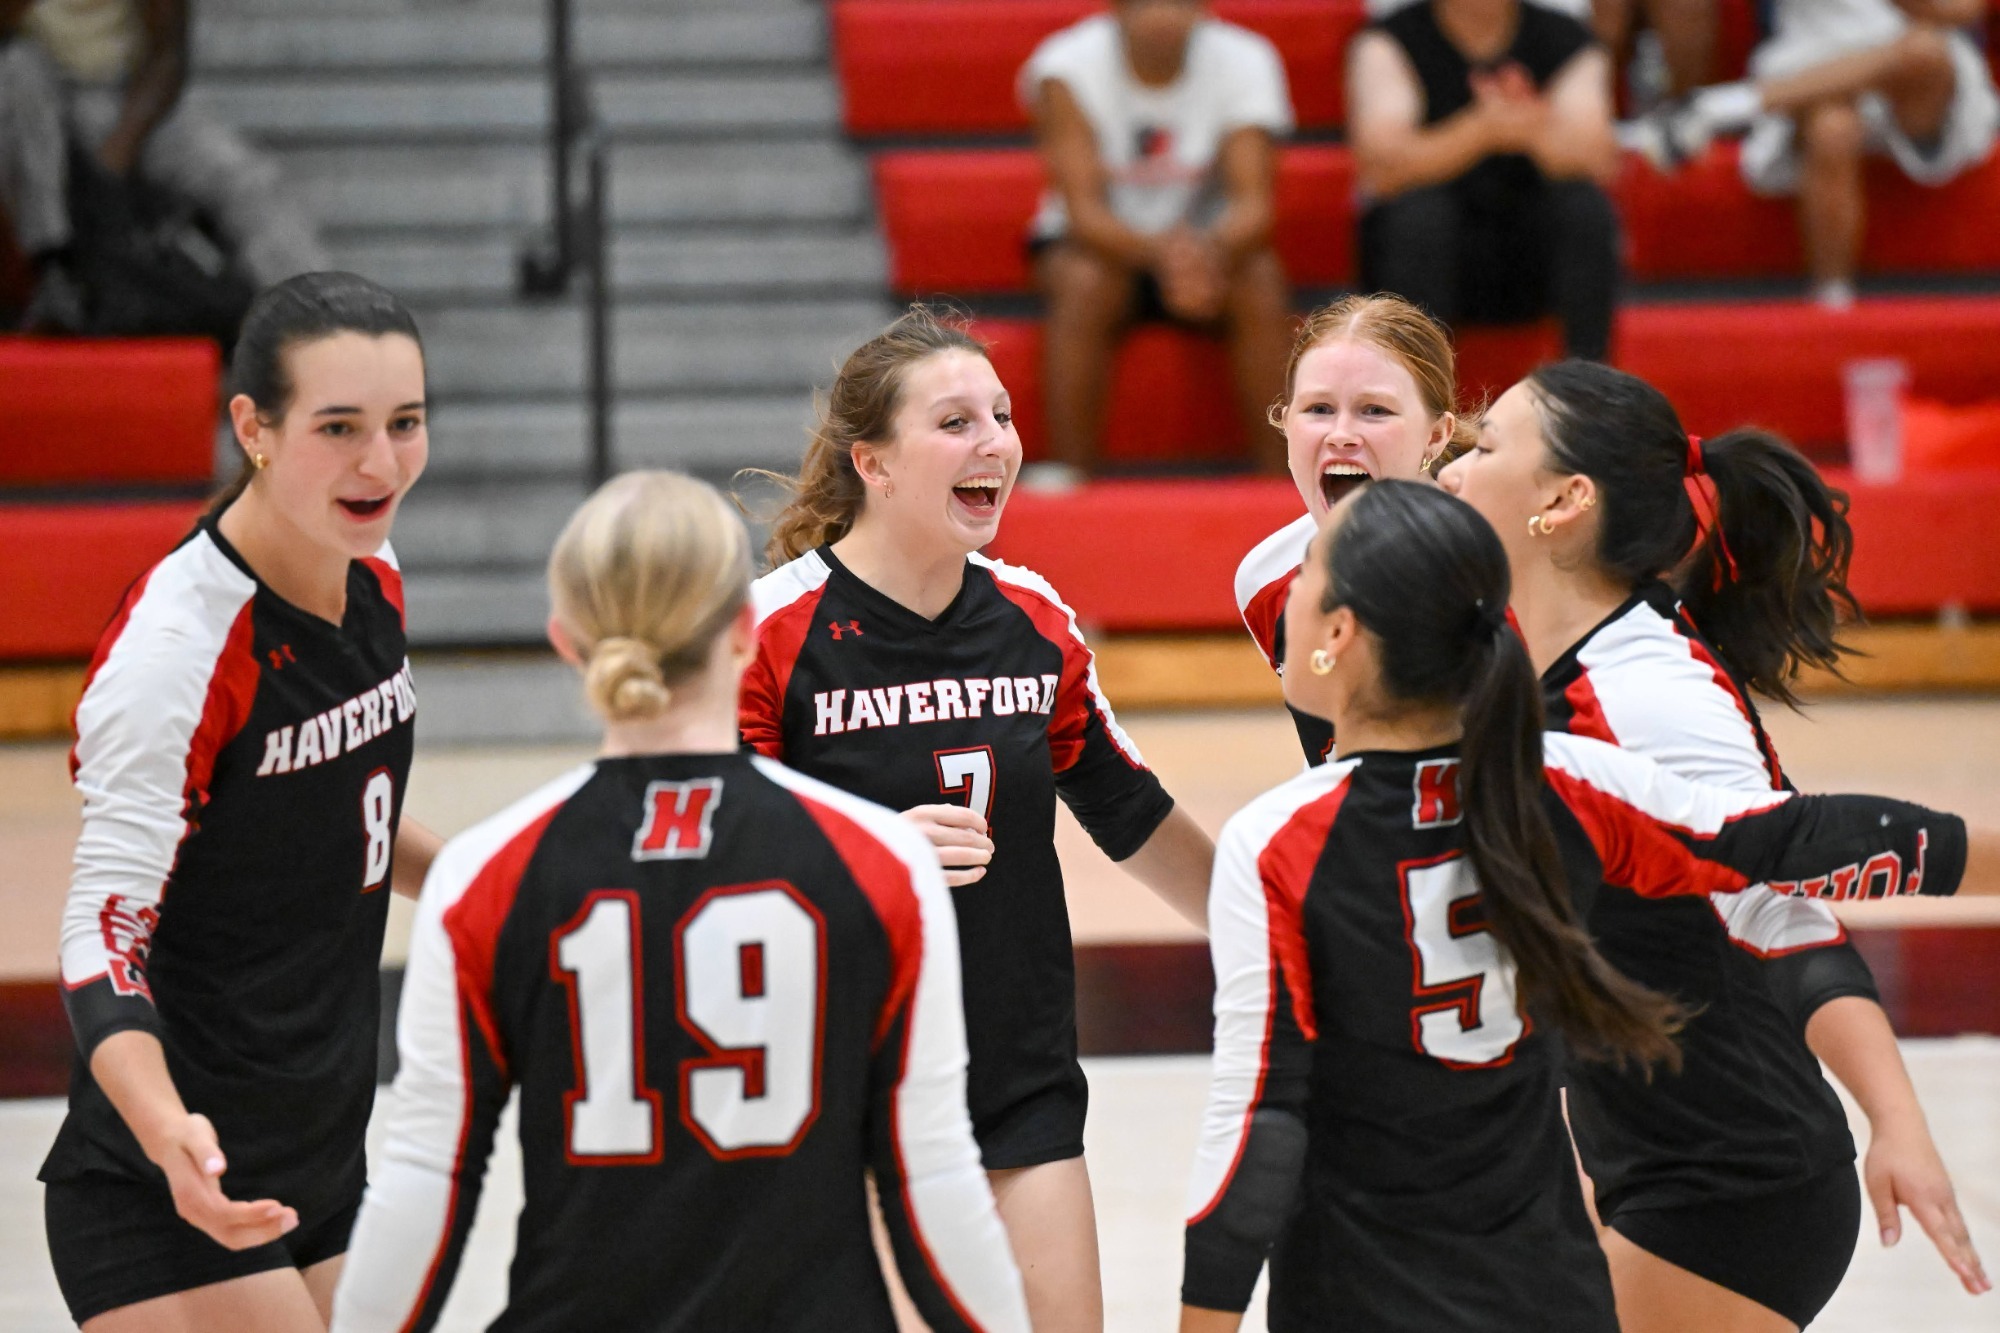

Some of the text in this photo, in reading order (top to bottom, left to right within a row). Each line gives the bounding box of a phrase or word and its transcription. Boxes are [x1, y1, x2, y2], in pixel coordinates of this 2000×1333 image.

[814, 674, 1059, 736] HAVERFORD
[361, 766, 394, 894] 8
[631, 776, 724, 862] H
[933, 744, 997, 838] 7
[1396, 850, 1534, 1071] 5
[549, 879, 828, 1166] 19
